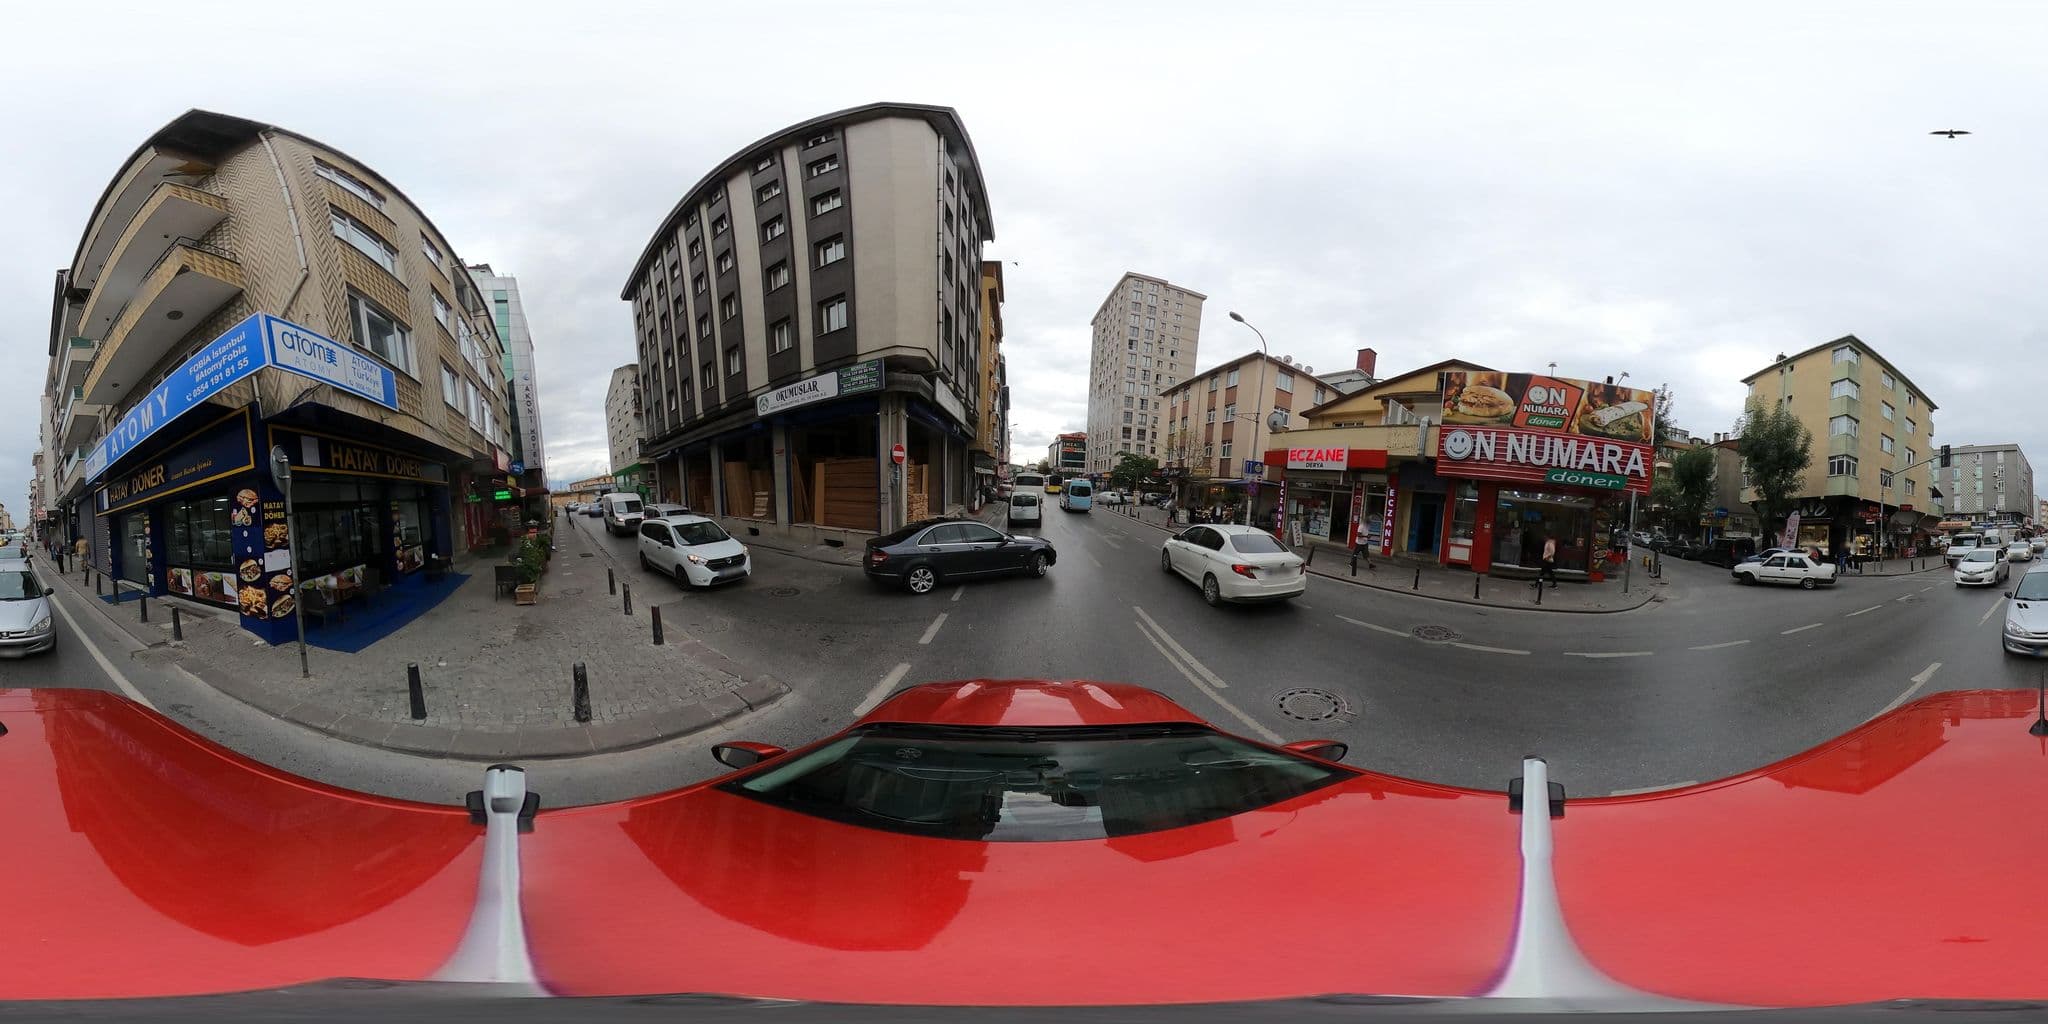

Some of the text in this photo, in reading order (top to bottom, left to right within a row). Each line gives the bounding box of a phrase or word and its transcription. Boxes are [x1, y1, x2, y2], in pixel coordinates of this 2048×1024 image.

[237, 356, 249, 370] 55
[294, 356, 331, 377] ATOMY
[1523, 404, 1569, 417] NUMARA
[111, 386, 169, 457] ATOMY
[1528, 416, 1563, 427] döner
[330, 442, 378, 471] HATAY
[1289, 448, 1344, 462] ECZANE
[1506, 432, 1646, 478] NUMARA
[1551, 470, 1620, 488] döner
[109, 481, 129, 503] HATAY
[263, 502, 284, 510] HATAY
[1277, 480, 1286, 528] ECZANE
[1384, 489, 1395, 547] ECZANE
